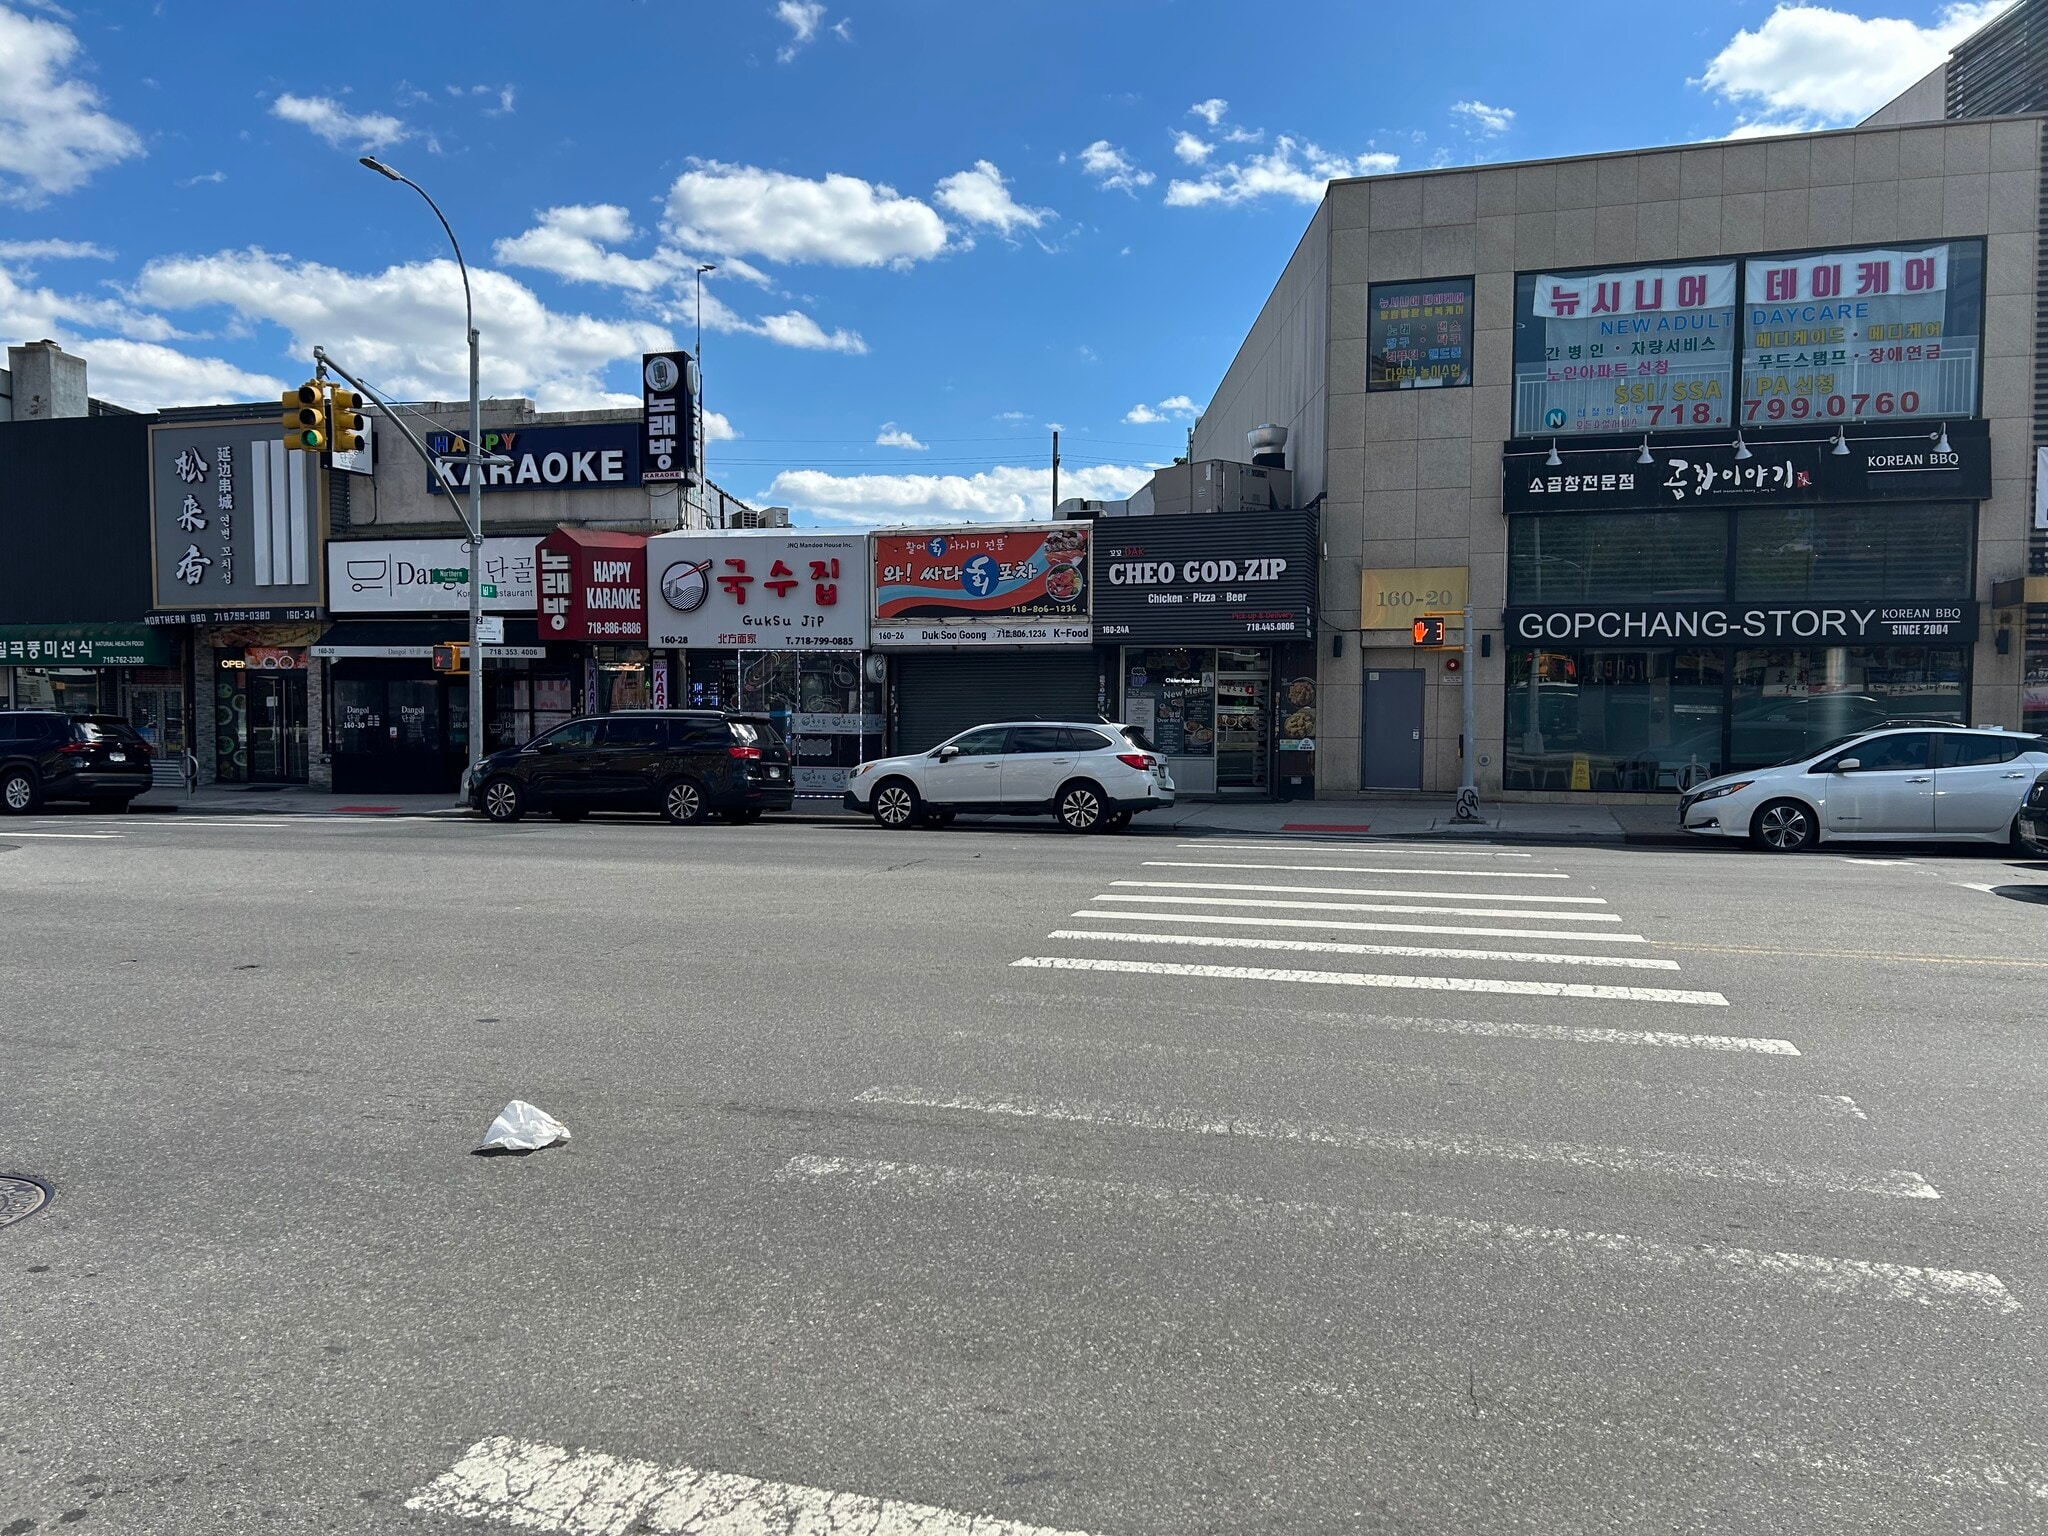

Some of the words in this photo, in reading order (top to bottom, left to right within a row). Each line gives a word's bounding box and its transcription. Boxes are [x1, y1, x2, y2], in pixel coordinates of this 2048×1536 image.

[1550, 274, 1708, 316] 뉴시니어
[1766, 257, 1935, 301] 데이케어
[1601, 318, 1651, 336] NEW
[1656, 312, 1735, 332] ADULT
[1753, 303, 1869, 326] DAYCARE
[1755, 327, 1845, 349] 메디케이드
[1868, 321, 1941, 341] 메디케어
[1631, 336, 1716, 356] 차량서비스
[1757, 350, 1846, 369] 푸드스탬프
[1868, 344, 1941, 364] 장애연금
[1547, 362, 1628, 382] 노인아파트
[1637, 360, 1669, 375] 신청
[1793, 373, 1835, 396] 신청
[1743, 391, 1920, 421] 799.0760
[648, 393, 676, 470] 노래방
[434, 432, 516, 453] HAPY
[1868, 454, 1923, 467] KOREAN
[1929, 452, 1960, 466] BBQ
[644, 471, 680, 479] KARAOKE
[1529, 473, 1635, 493] 소곱창전문점
[1663, 458, 1794, 500] 곱창이야기
[949, 540, 980, 551] 사시미
[985, 538, 1005, 551] 전문
[1124, 547, 1145, 557] DAK
[485, 556, 535, 583] 단골
[593, 561, 631, 583] HAPPY
[883, 563, 913, 582] 와!
[1108, 561, 1176, 585] CHEO
[1182, 558, 1287, 583] GOD.ZIP
[541, 549, 569, 631] 노래방
[716, 557, 840, 606] 국수집
[496, 589, 533, 598] estaurant
[586, 587, 641, 610] KARAOKE
[1148, 593, 1183, 603] Chicken
[1192, 593, 1216, 603] Pizza
[1226, 592, 1247, 602] Beer
[1376, 590, 1453, 607] 160-20
[144, 614, 186, 625] NORTHERN
[286, 610, 315, 620] 160-34
[1010, 605, 1077, 614] 718-806-1236
[1881, 608, 1930, 619] KOREAN
[1935, 607, 1961, 619] BBQ
[587, 622, 641, 634] 718-886-6886
[742, 614, 792, 626] GukSu
[1519, 609, 1876, 639] GOPCHANG-STORY
[717, 633, 757, 644] 北方面家
[878, 631, 905, 640] 160-26
[921, 630, 940, 640] Duk
[940, 631, 957, 640] Soo
[959, 630, 987, 641] Goong
[1053, 628, 1089, 638] K-Food
[1102, 625, 1130, 634] 160-24A
[1436, 622, 1443, 641] 3
[1892, 625, 1921, 636] SINCE
[1923, 624, 1949, 635] 2004
[660, 635, 689, 644] 160-28
[102, 656, 144, 664] 718-762-3300
[1164, 690, 1183, 699] New
[1185, 687, 1208, 696] Menu
[347, 706, 370, 716] Dangol
[401, 706, 425, 716] Dangol
